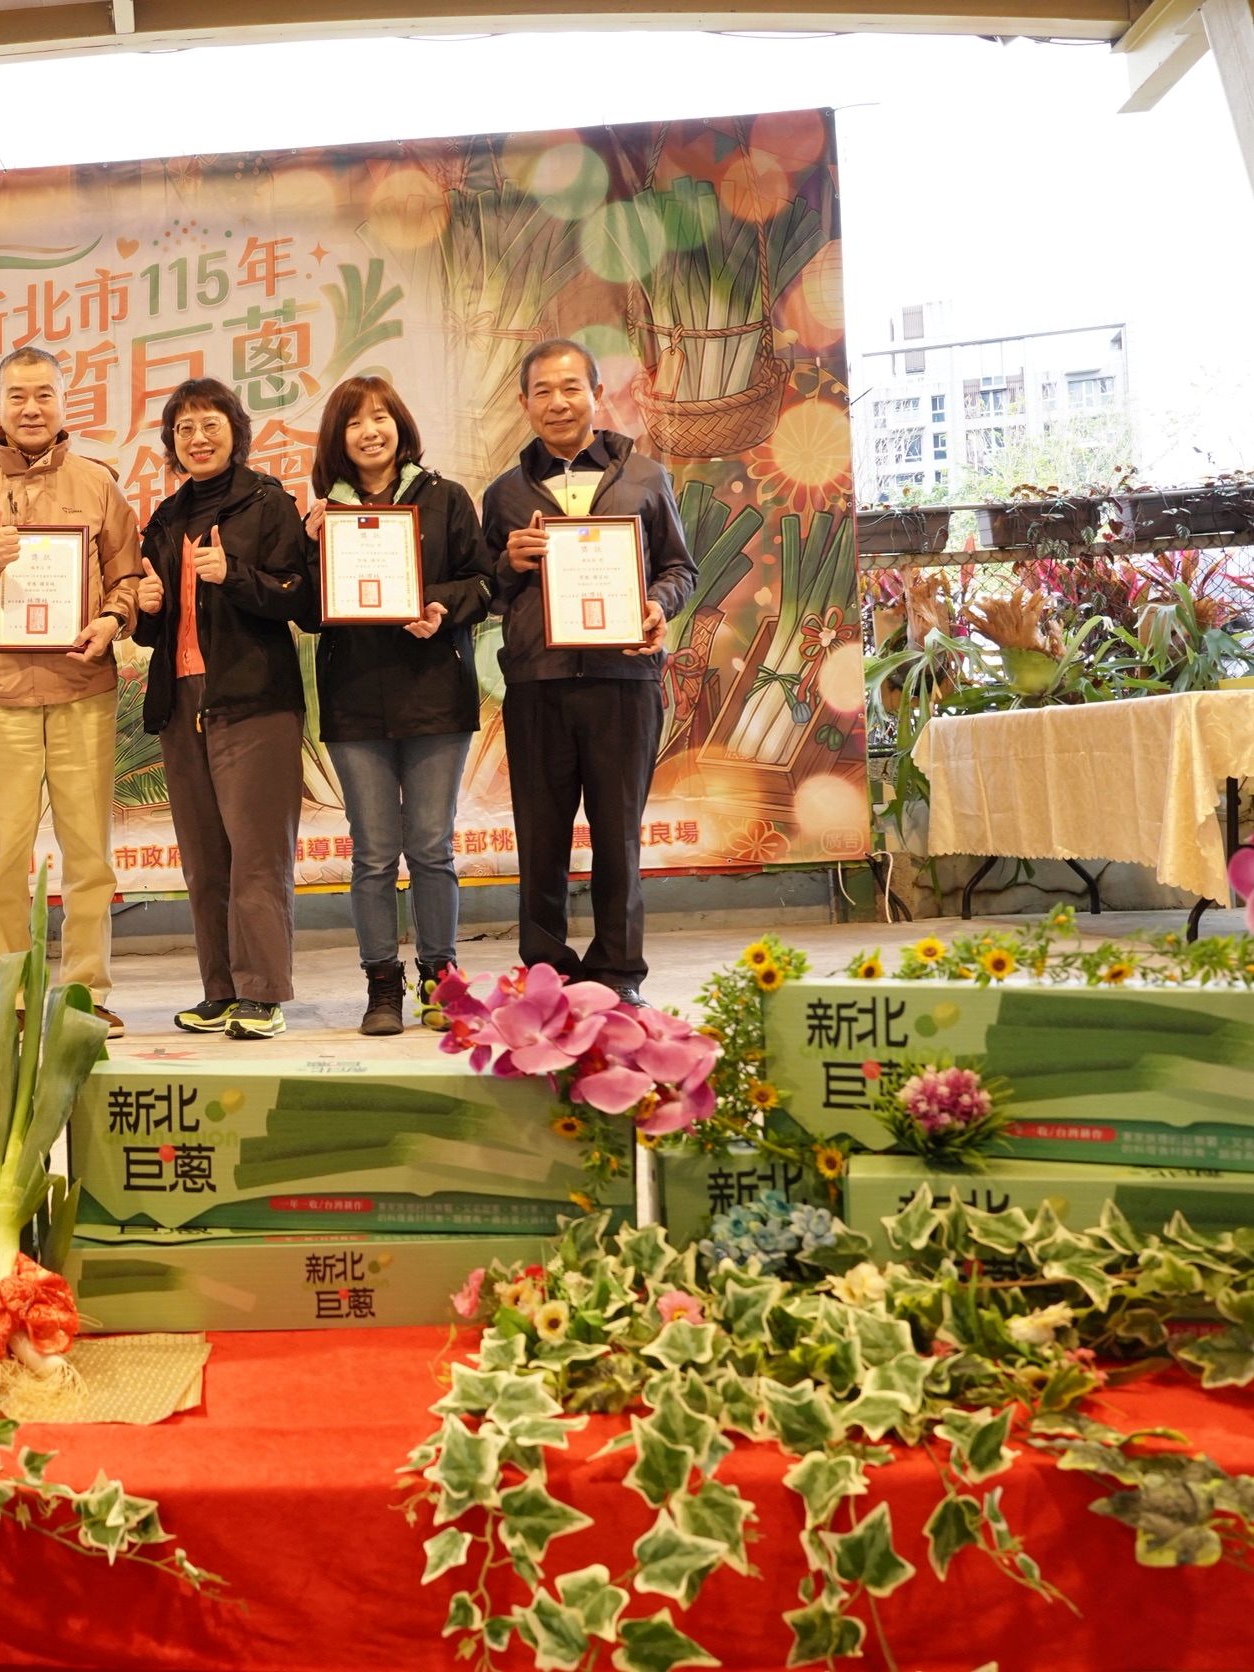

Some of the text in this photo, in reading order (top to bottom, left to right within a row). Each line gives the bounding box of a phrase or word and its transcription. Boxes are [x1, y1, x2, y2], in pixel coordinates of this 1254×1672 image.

[806, 996, 908, 1051] 新北
[108, 1084, 200, 1136] 新北
[123, 1143, 217, 1193] 巨蔥
[305, 1251, 365, 1284] 新北
[315, 1287, 375, 1319] 巨蔥
